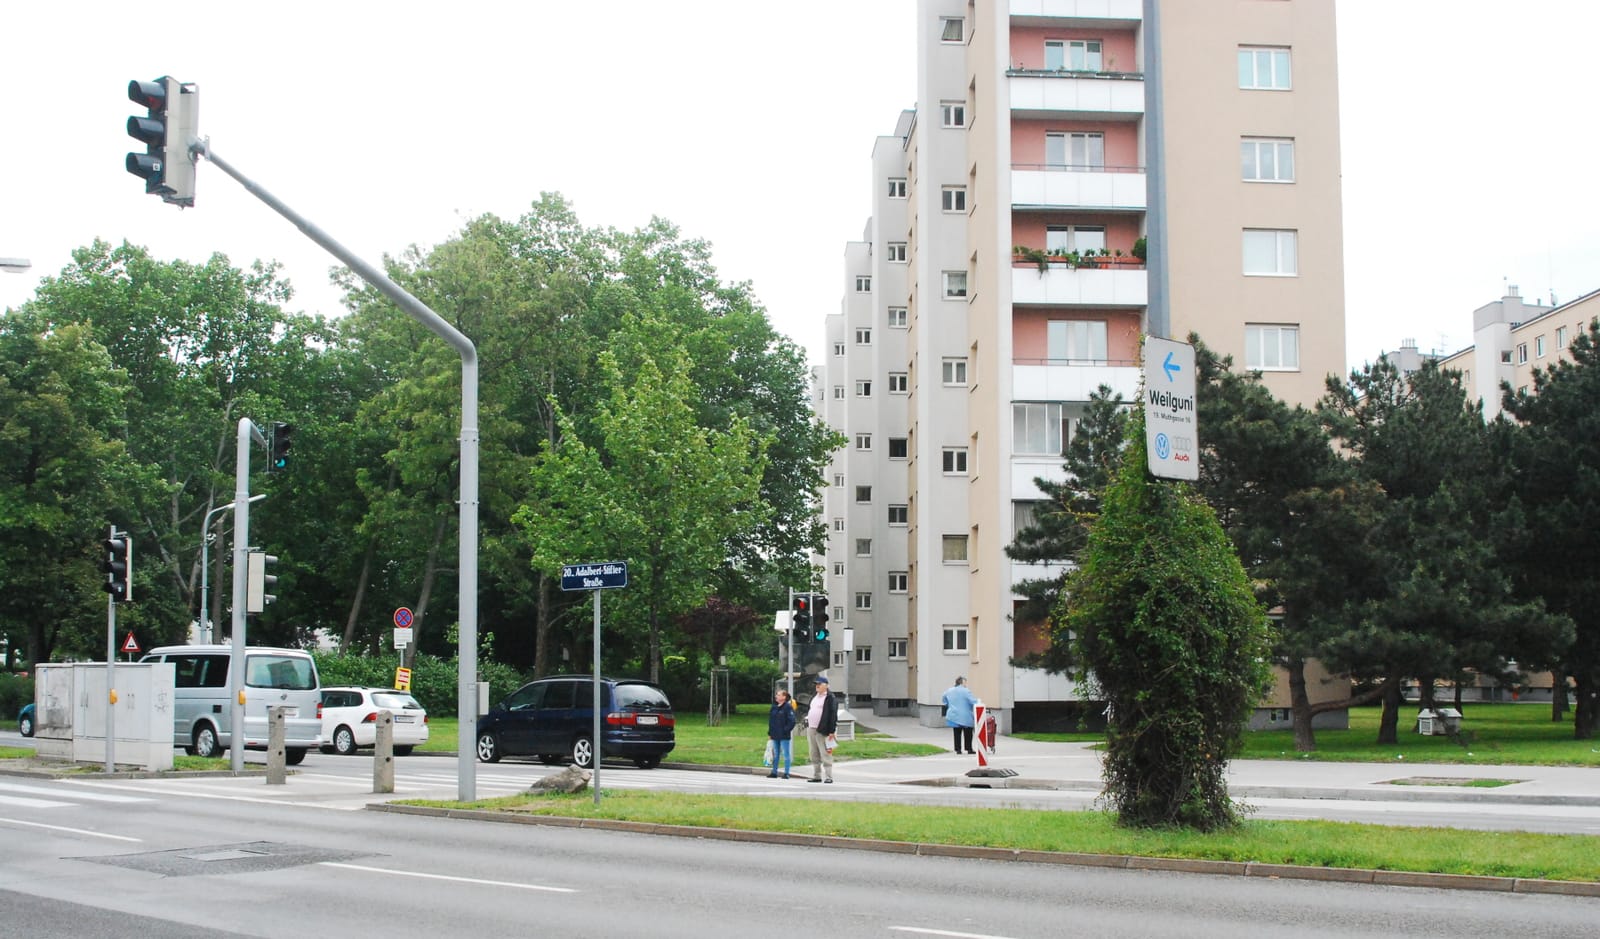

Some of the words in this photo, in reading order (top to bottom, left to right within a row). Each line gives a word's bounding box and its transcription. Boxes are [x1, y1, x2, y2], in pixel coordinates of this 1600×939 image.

[1149, 389, 1193, 412] Weilguni
[1174, 453, 1190, 462] Audi
[583, 577, 604, 587] Straße
